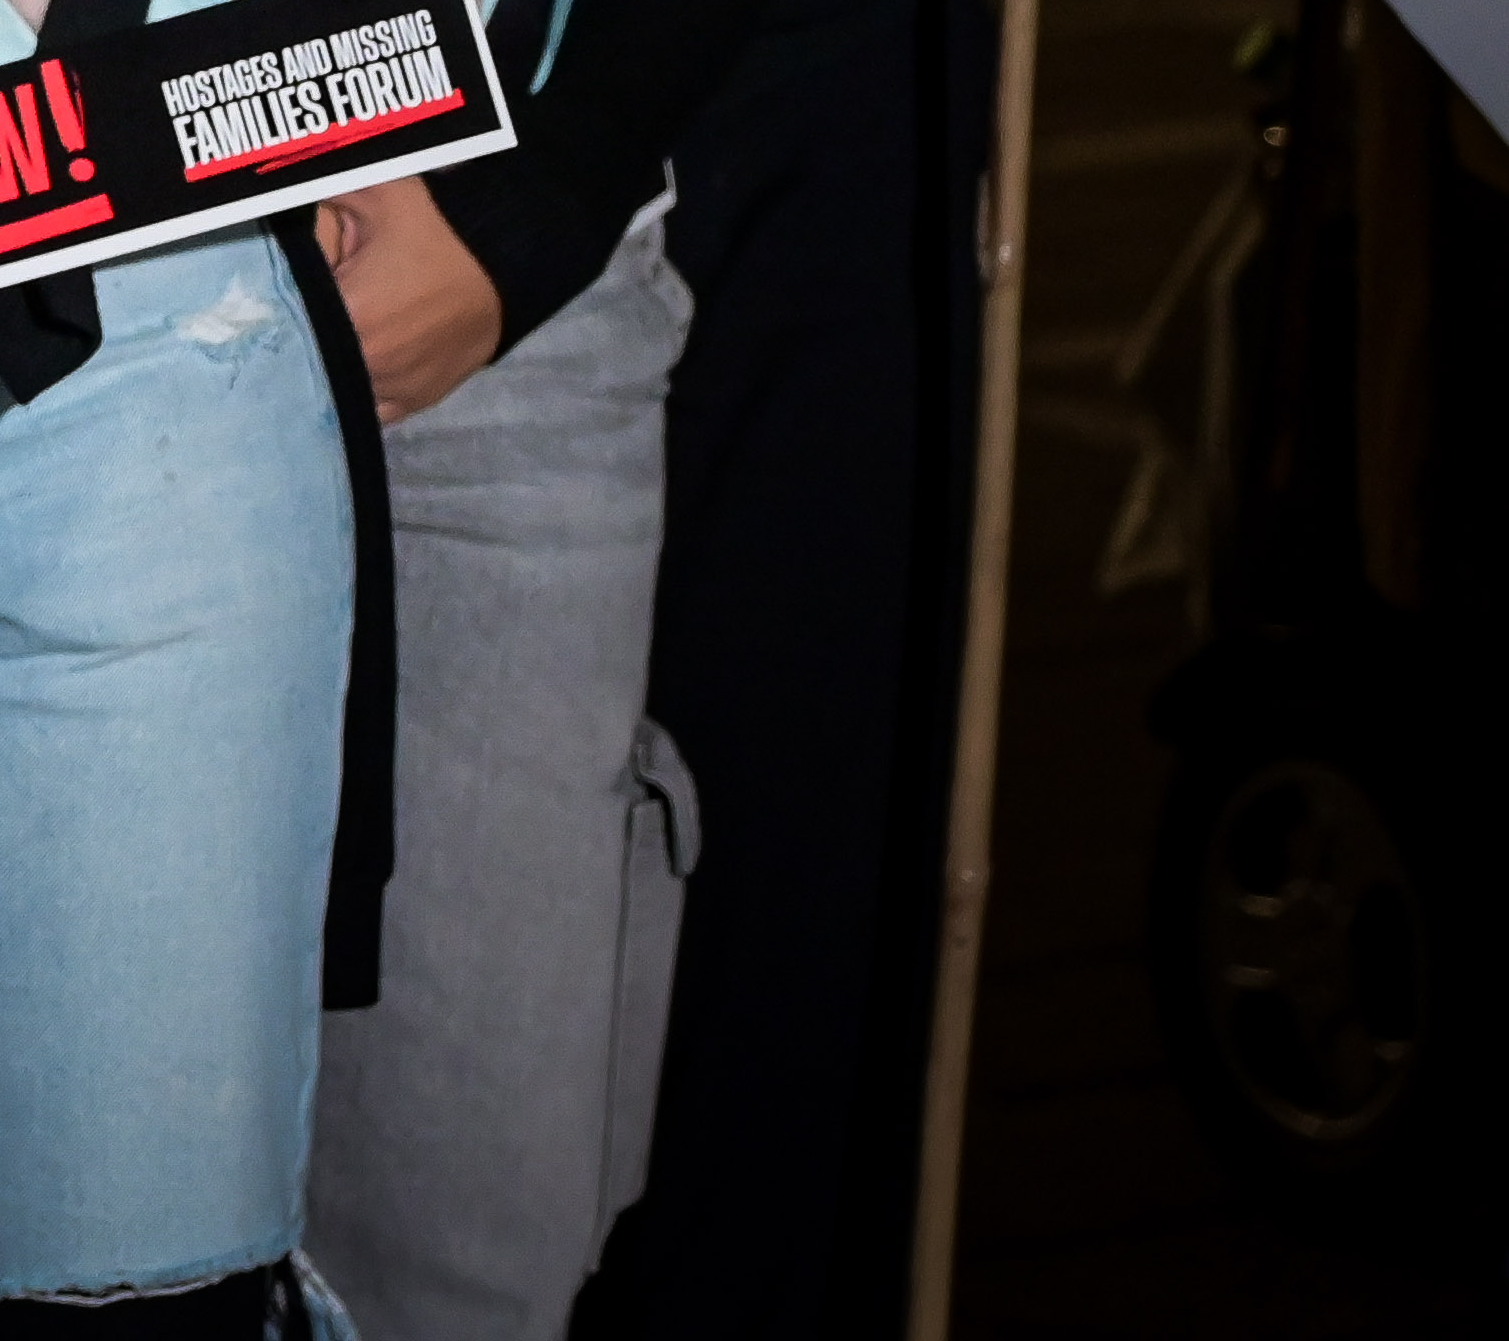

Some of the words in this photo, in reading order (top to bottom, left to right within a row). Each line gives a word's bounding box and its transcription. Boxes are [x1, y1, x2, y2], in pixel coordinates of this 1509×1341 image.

[161, 51, 283, 116] HOSTAGES
[281, 38, 333, 85] AND
[329, 9, 439, 70] MISSING
[173, 80, 331, 170] FAMILIES
[325, 46, 455, 128] FORUM
